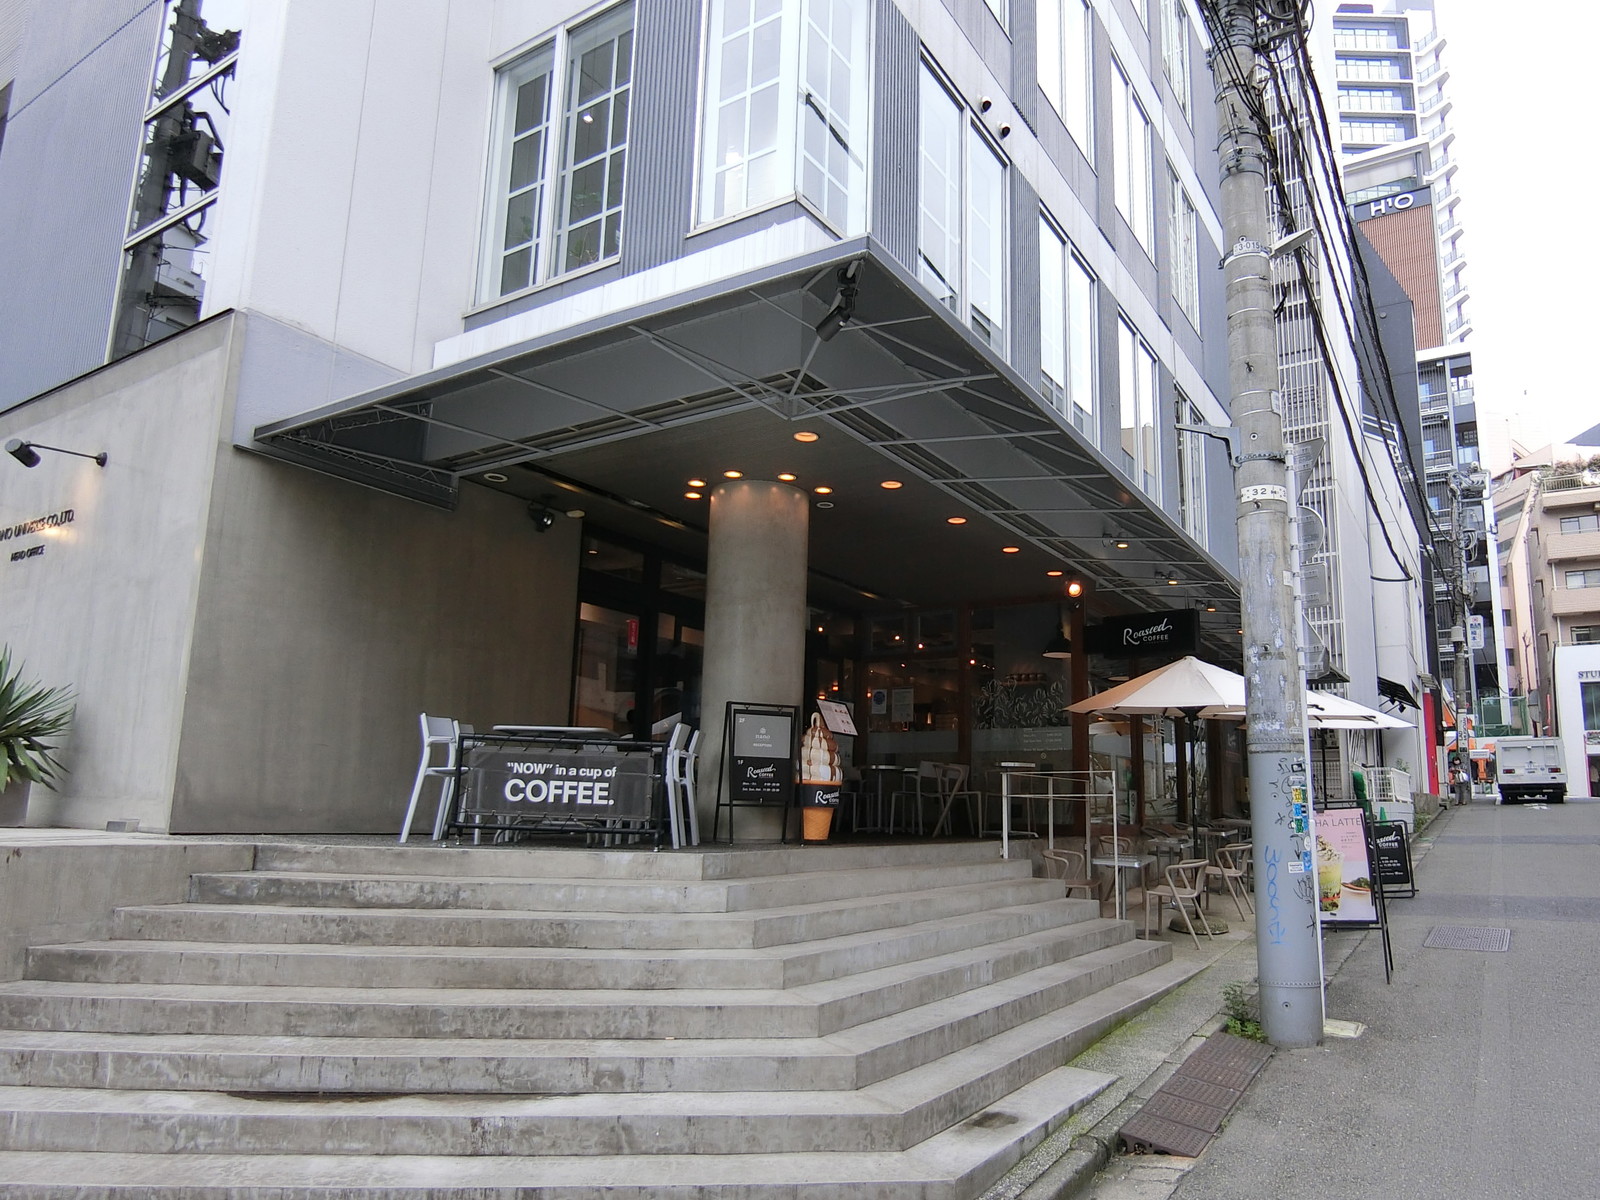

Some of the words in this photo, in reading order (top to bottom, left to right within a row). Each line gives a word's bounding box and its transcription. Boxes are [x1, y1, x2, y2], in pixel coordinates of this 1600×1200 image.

[1123, 617, 1173, 645] Roasted
[555, 764, 567, 776] in
[568, 767, 577, 776] a
[579, 767, 603, 780] cup
[604, 766, 617, 778] of
[504, 778, 615, 806] COFFEE.
[1331, 817, 1362, 827] LATTE
